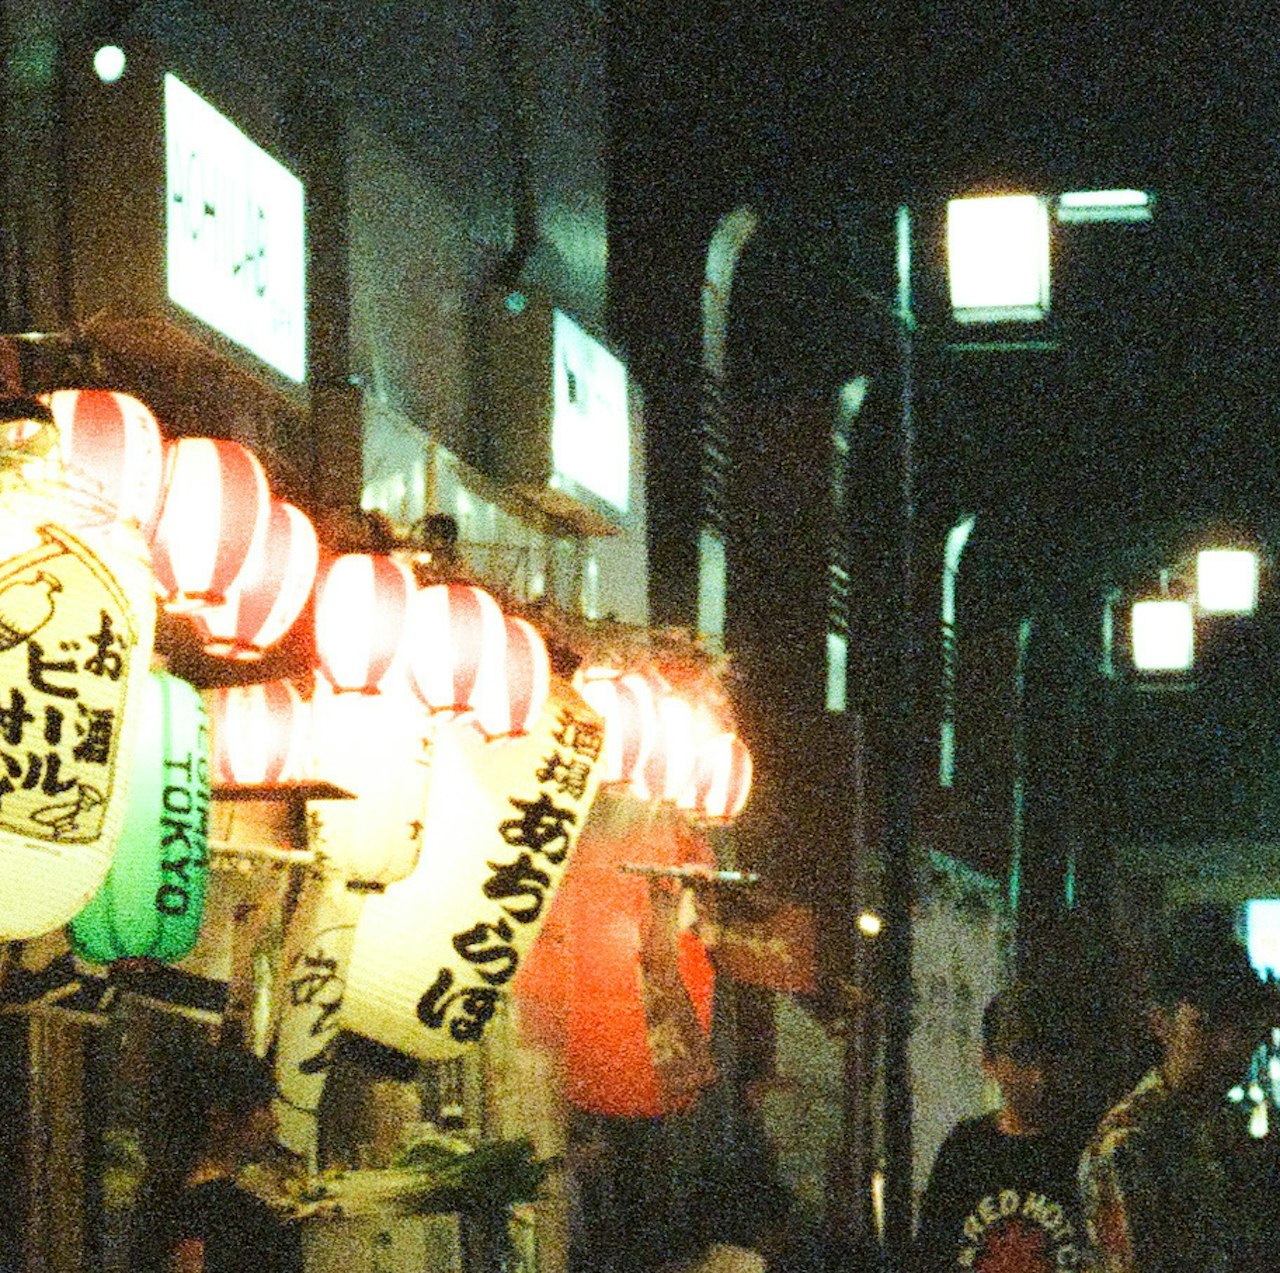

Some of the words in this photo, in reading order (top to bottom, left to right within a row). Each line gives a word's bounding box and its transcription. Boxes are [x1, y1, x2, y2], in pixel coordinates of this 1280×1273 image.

[22, 639, 80, 796] ビール
[72, 609, 127, 765] お酒
[155, 752, 192, 916] TOKYO
[963, 1189, 1021, 1242] RED
